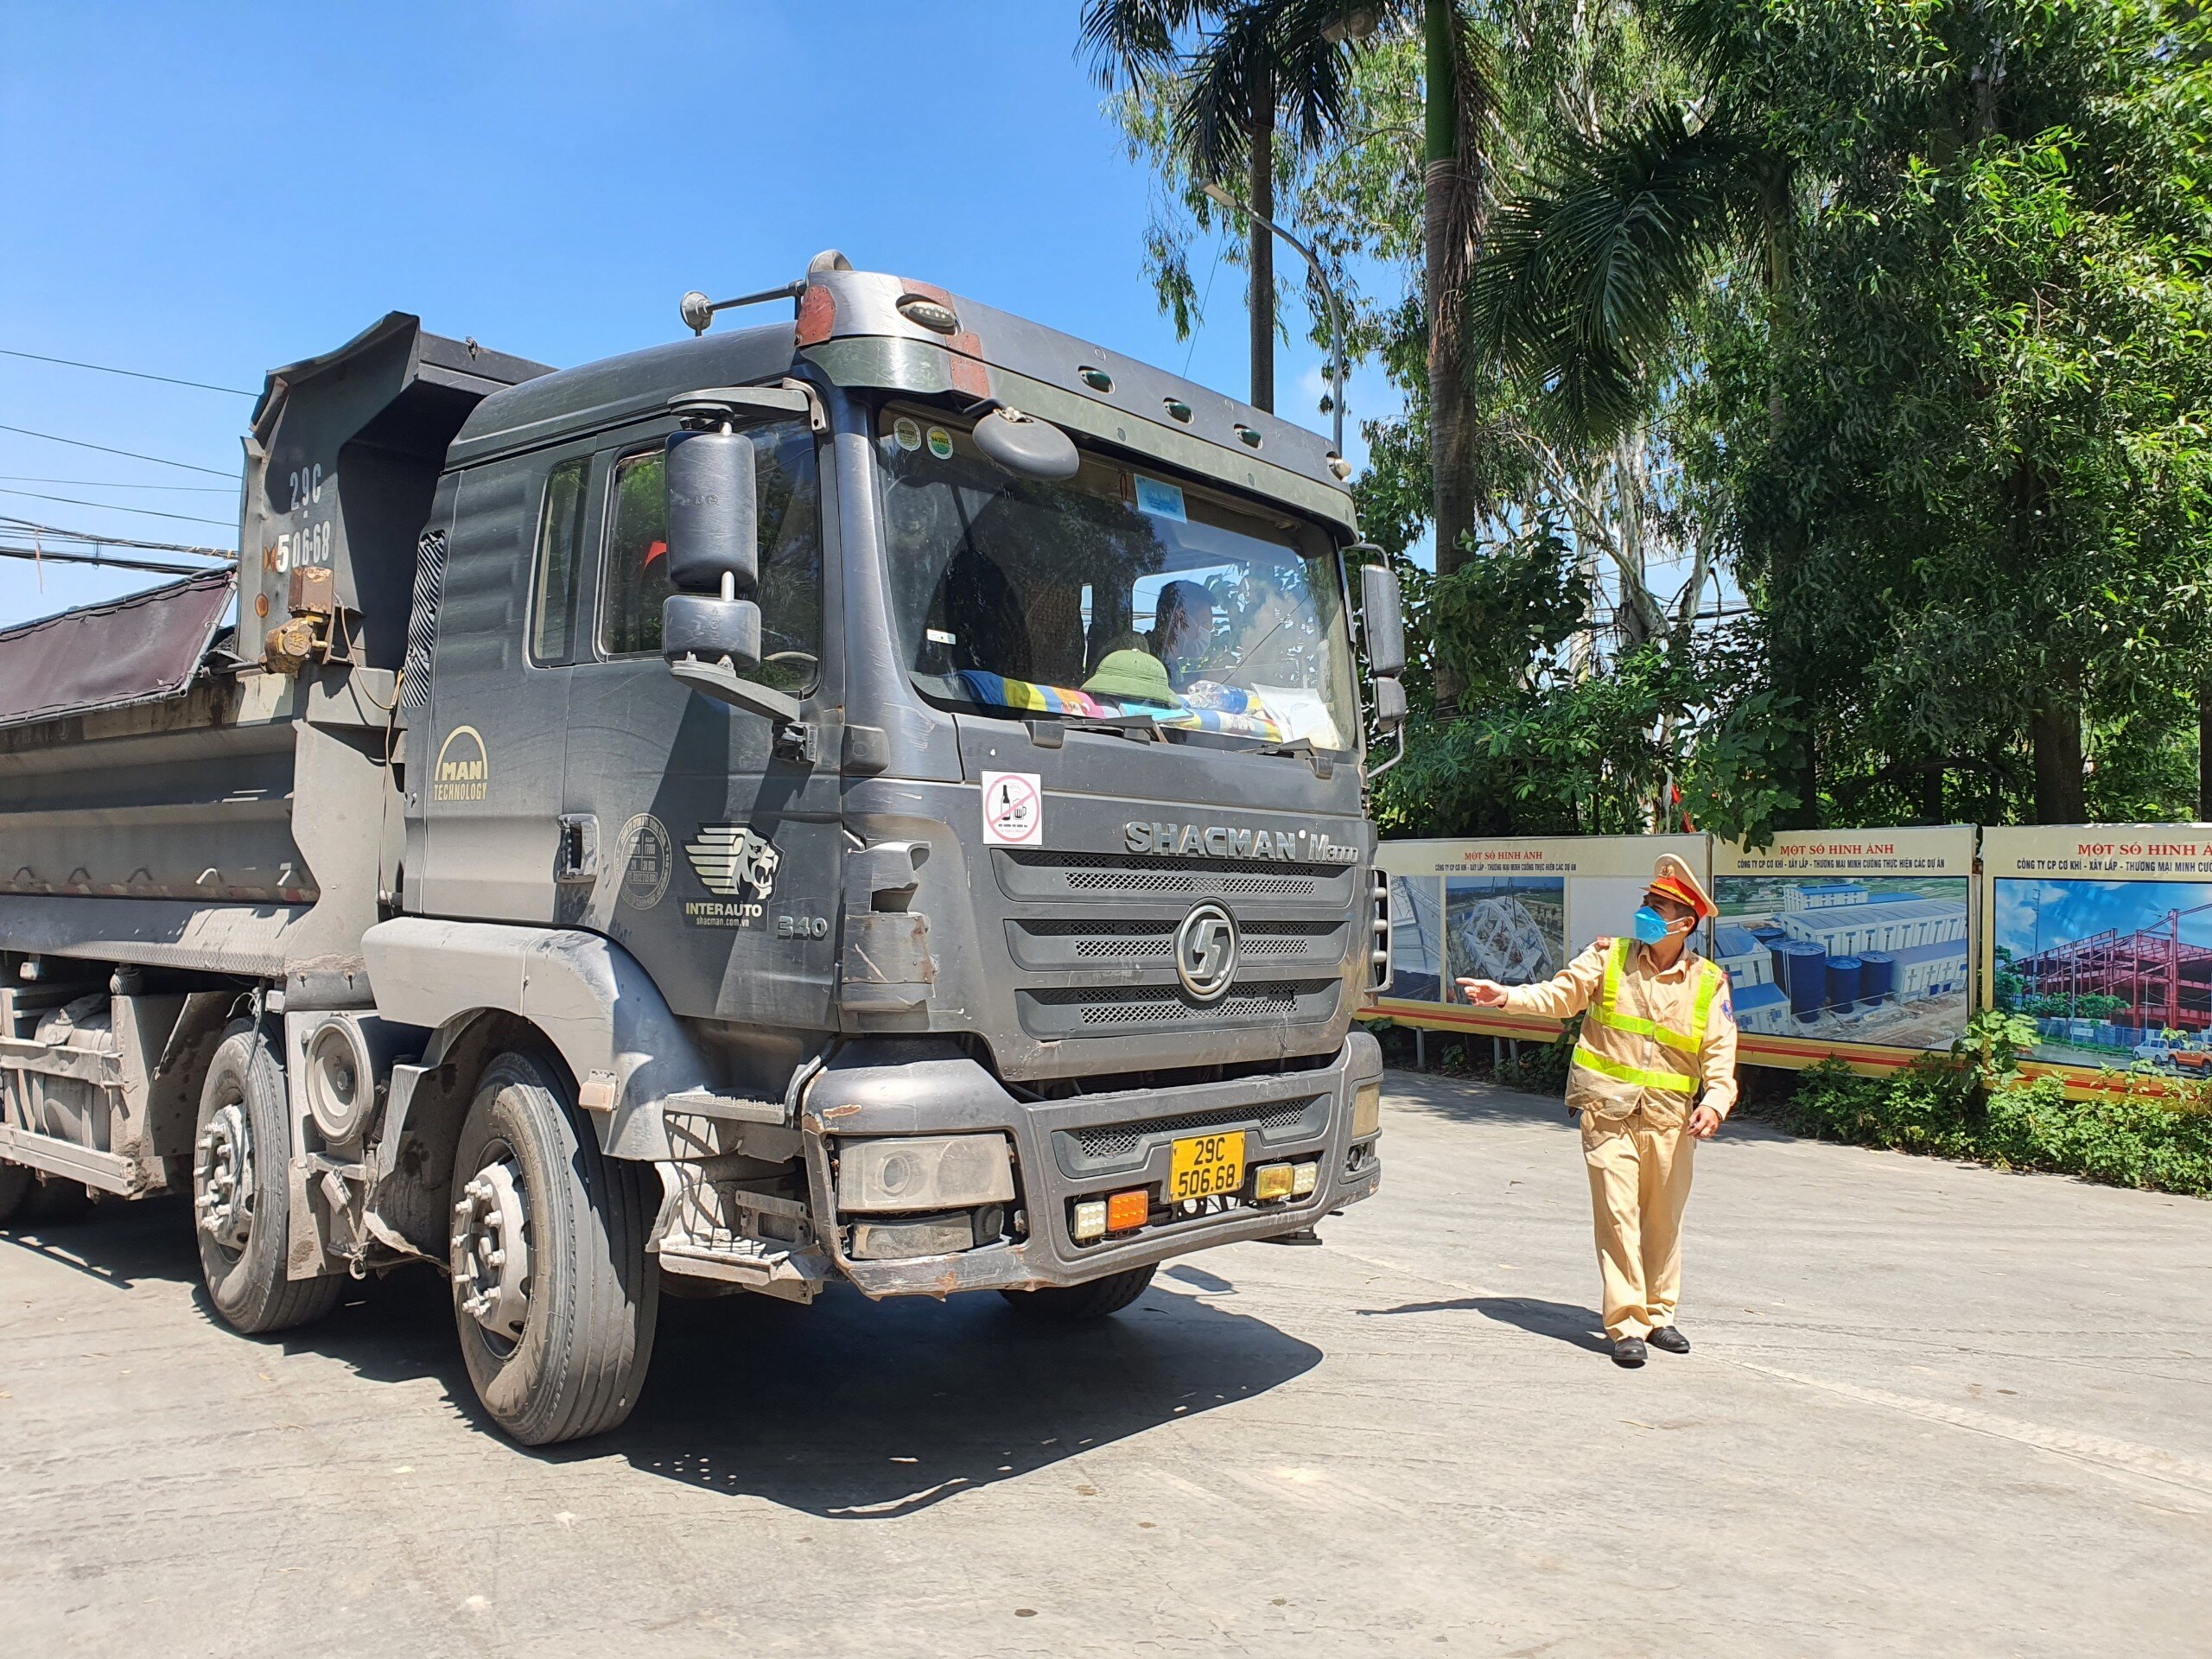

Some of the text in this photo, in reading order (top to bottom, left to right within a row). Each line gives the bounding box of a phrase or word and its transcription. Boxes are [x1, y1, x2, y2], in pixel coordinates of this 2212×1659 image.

[289, 462, 321, 511] 29C
[442, 760, 482, 781] MAN
[434, 783, 487, 801] TECHNOLOGY
[1125, 821, 1295, 861] SHACMAN
[1780, 842, 1894, 856] MỘT SỐ HÌNH ẢNH
[2077, 842, 2114, 857] MỘT
[2120, 842, 2142, 855] SỐ
[2147, 842, 2196, 855] HÌNH
[1738, 859, 1751, 868] CÔNG
[1751, 860, 1758, 868] TY
[1759, 860, 1765, 868] CP
[1914, 857, 1925, 868] CÁC
[2017, 857, 2035, 869] CÔNG
[2037, 860, 2045, 869] TY
[2047, 860, 2056, 870] CP
[2058, 859, 2069, 870] CƠ
[2070, 858, 2082, 870] KHÍ
[2089, 858, 2102, 871] XÂY
[2105, 858, 2118, 871] LẮP
[2126, 860, 2155, 872] THƯƠNG
[2158, 861, 2172, 874] MẠI
[2175, 861, 2196, 872] MINH
[685, 902, 762, 918] INTERAUTO
[696, 916, 749, 928] shacman.com.vn
[778, 915, 827, 939] 340
[1193, 1136, 1225, 1166] 29C
[1178, 1163, 1236, 1198] 506.68
